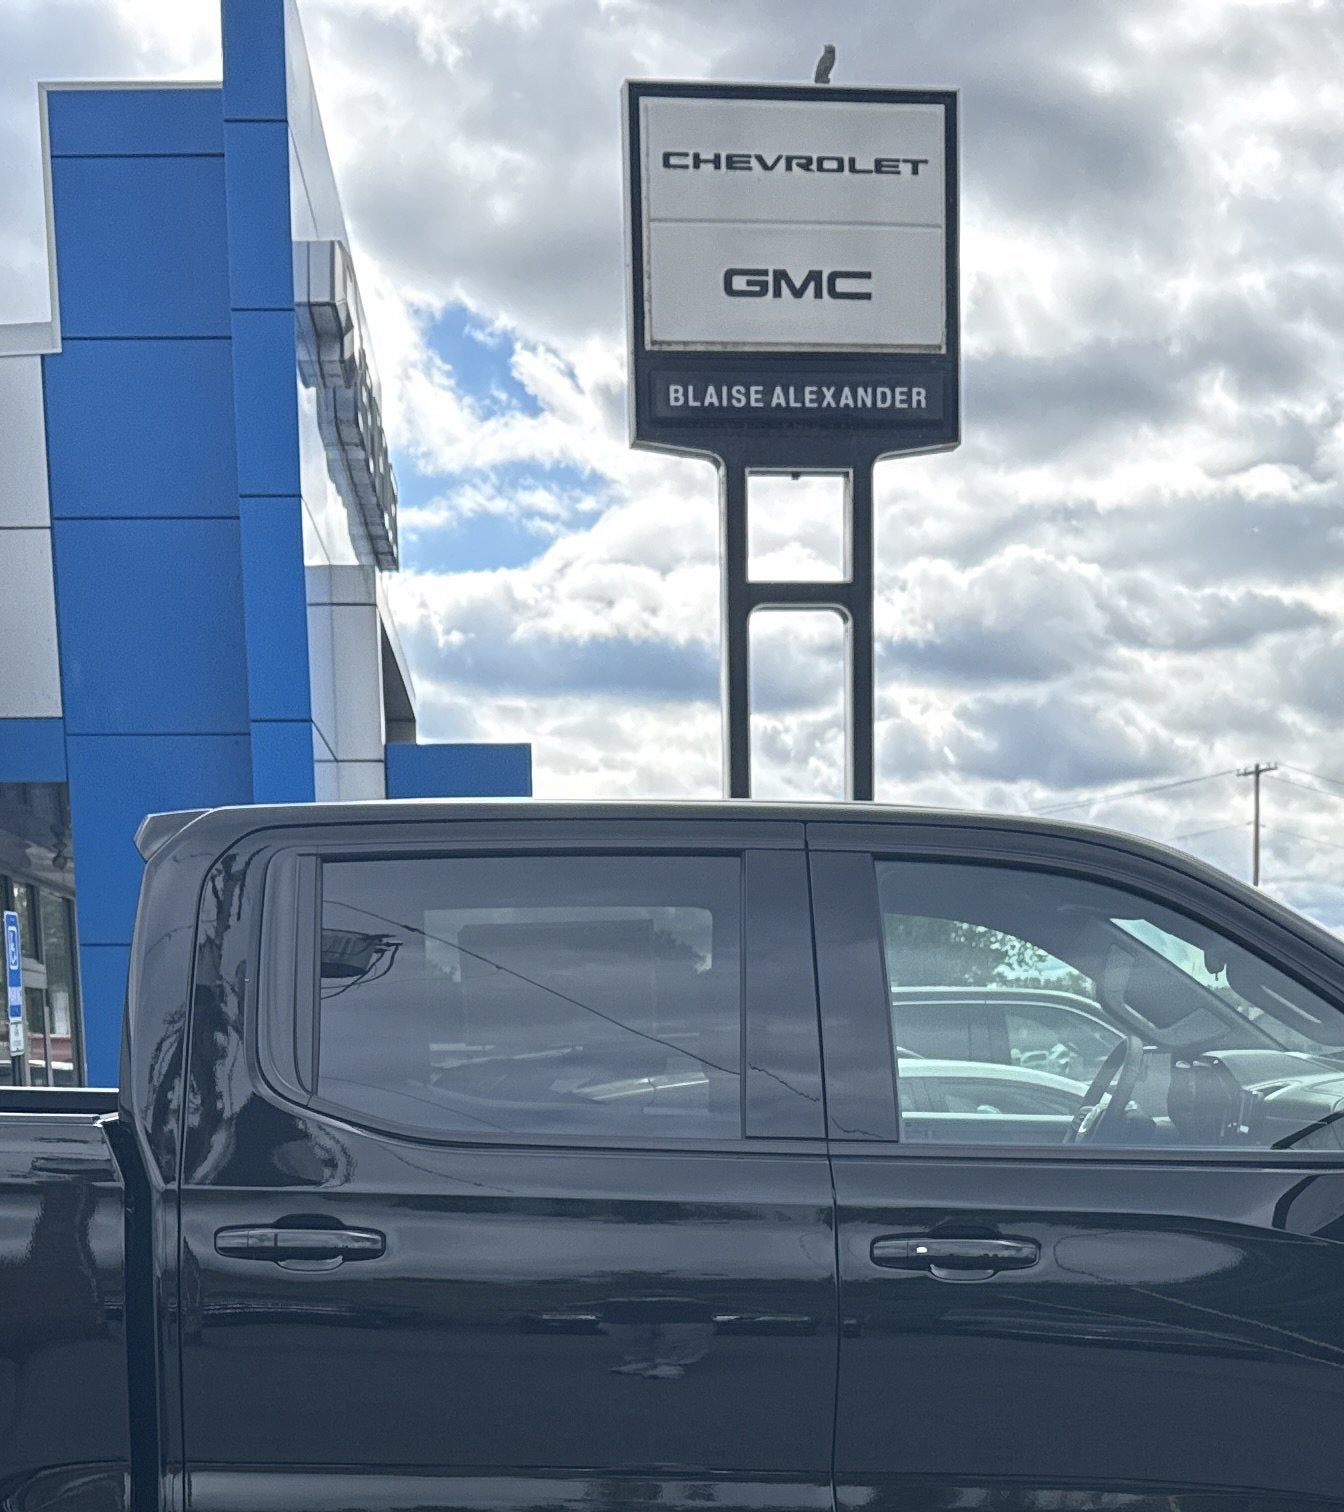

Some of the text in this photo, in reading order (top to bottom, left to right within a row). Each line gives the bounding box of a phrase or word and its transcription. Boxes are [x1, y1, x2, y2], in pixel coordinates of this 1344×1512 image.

[661, 151, 929, 176] CHEVROLET
[723, 267, 873, 301] GMC
[668, 384, 928, 409] BLAISE ALEXANDER
